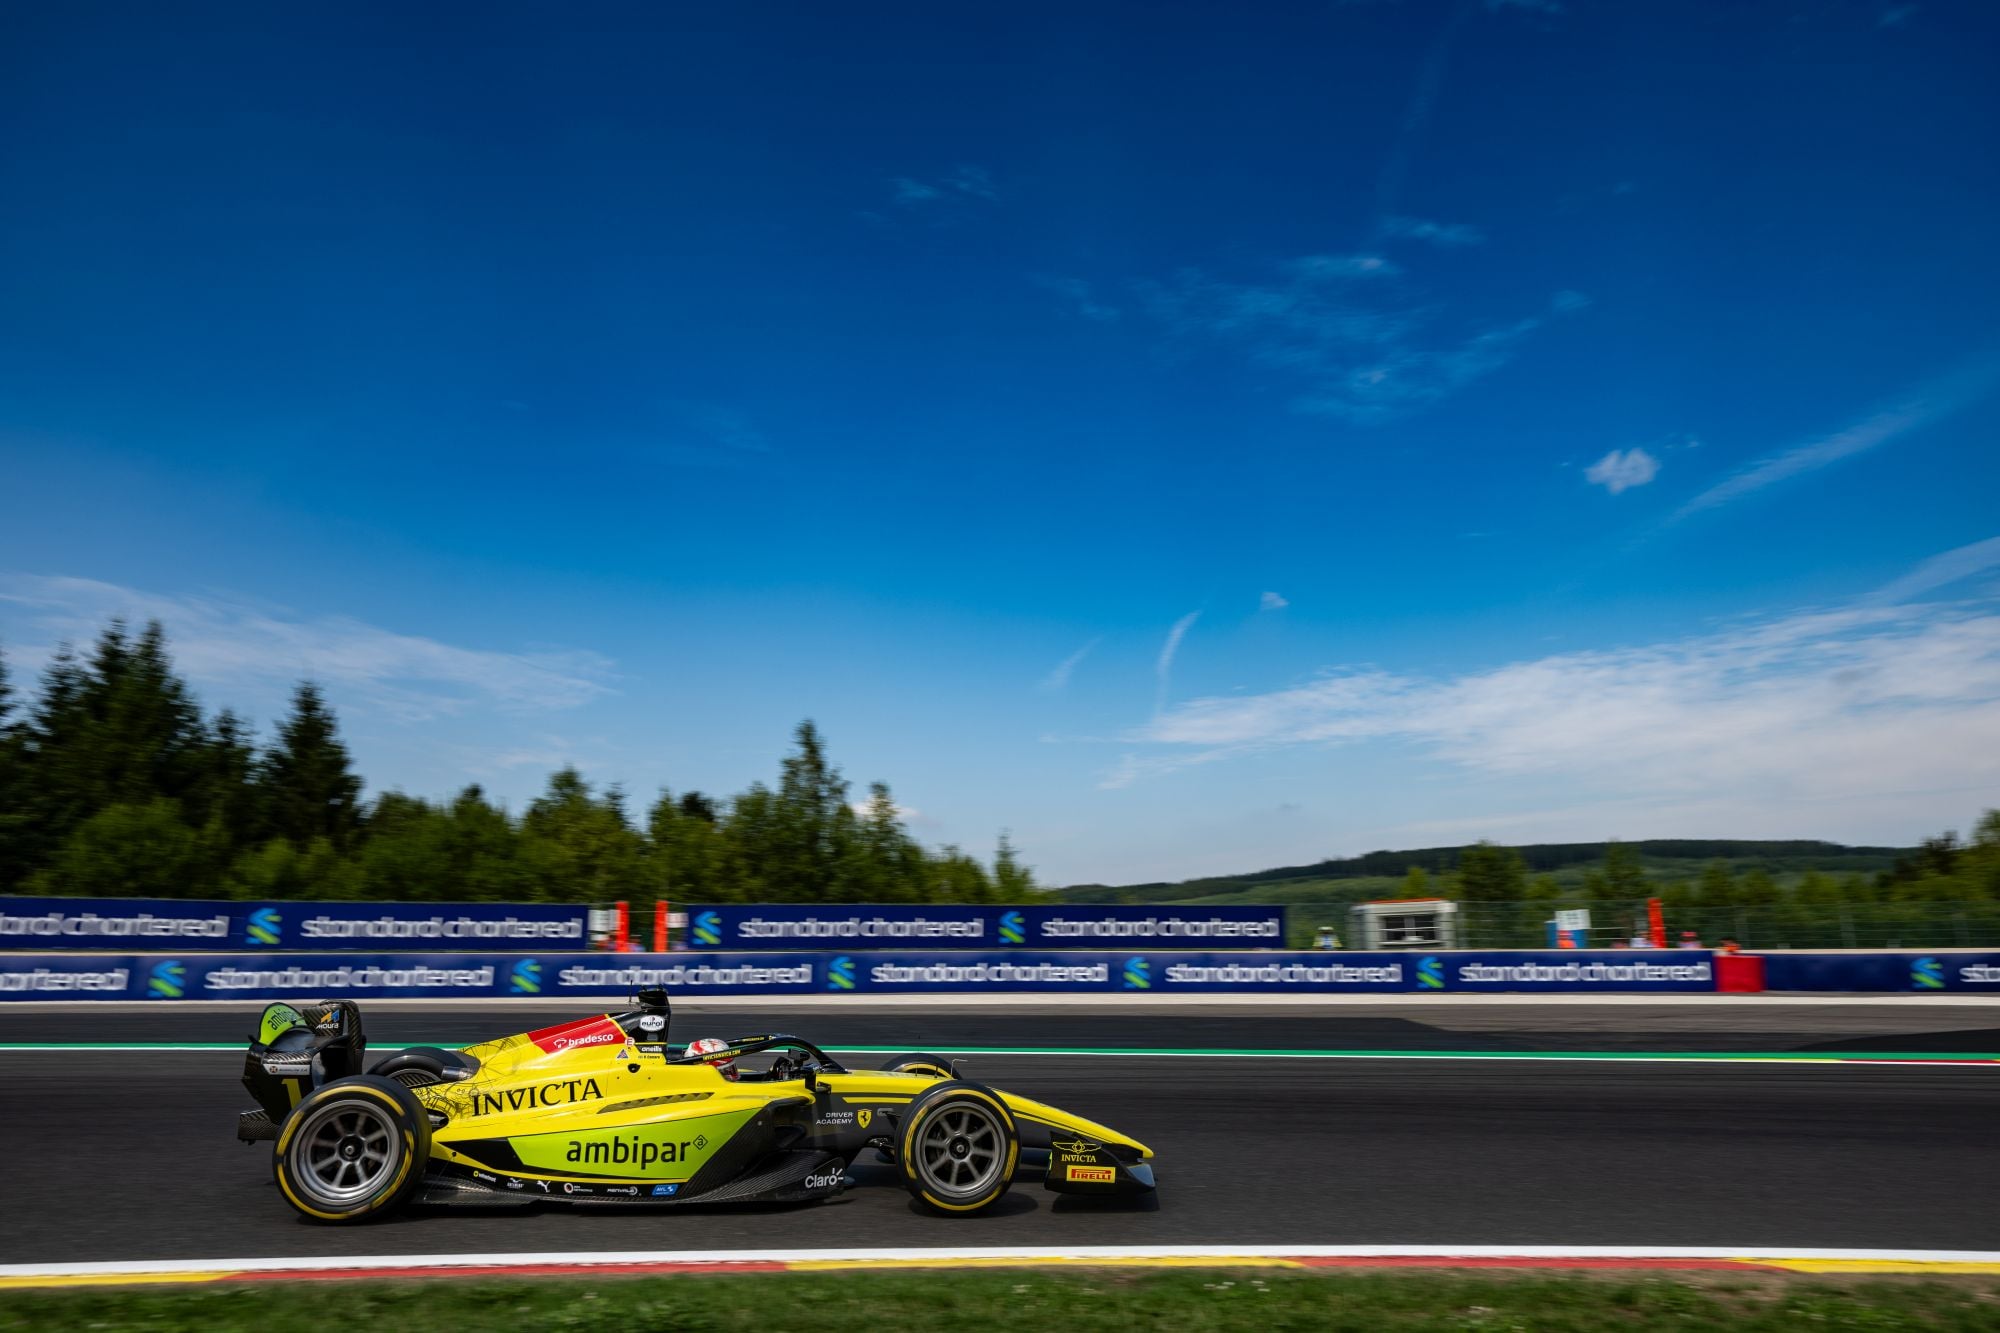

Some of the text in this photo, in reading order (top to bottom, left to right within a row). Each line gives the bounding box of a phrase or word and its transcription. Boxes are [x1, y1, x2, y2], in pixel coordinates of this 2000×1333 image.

[62, 913, 229, 937] chartered
[300, 916, 445, 938] standard
[443, 916, 582, 938] chartered
[738, 918, 984, 938] standard chartered
[1041, 918, 1279, 937] standard chartered
[204, 966, 494, 989] standard chartered
[559, 964, 812, 986] standard chartered
[871, 963, 1108, 982] standard chartered
[1165, 963, 1402, 983] standard chartered
[1459, 961, 1712, 982] standard chartered
[568, 1034, 614, 1046] bradesco
[472, 1078, 604, 1116] INVICTA
[566, 1135, 691, 1170] ambipar
[1061, 1154, 1097, 1163] INVICTA
[804, 1172, 839, 1188] Claro
[1071, 1169, 1112, 1180] PIRELLI
